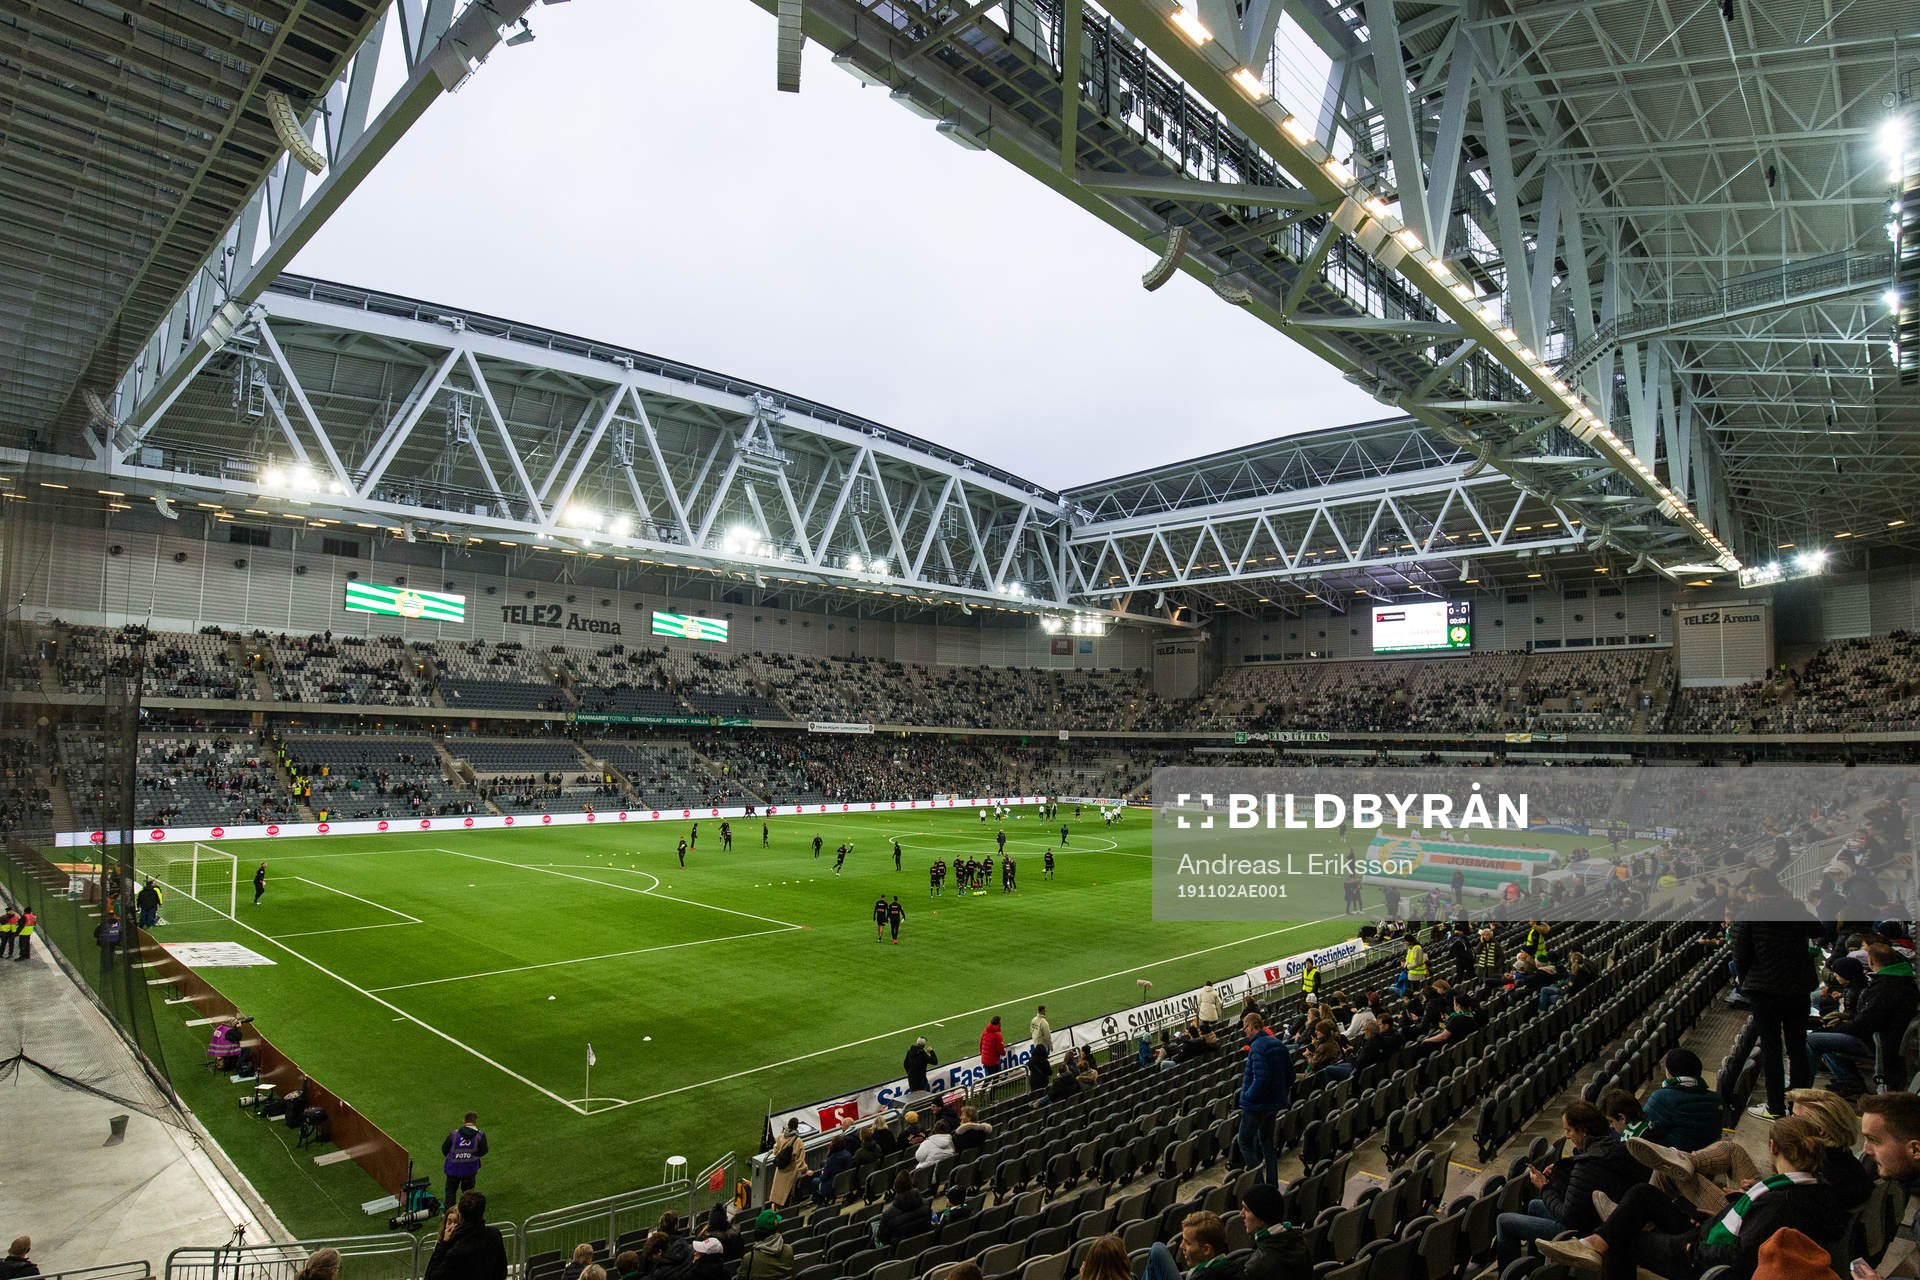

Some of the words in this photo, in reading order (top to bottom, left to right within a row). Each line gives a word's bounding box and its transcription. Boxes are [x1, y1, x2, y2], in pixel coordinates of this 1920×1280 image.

[1448, 607, 1454, 615] 0
[1461, 606, 1467, 614] 0
[501, 604, 562, 629] TELE2
[566, 613, 621, 635] Arena
[1683, 612, 1720, 626] TELE2
[1724, 614, 1760, 624] Arena
[1447, 857, 1505, 870] JOBMAN
[1286, 959, 1308, 975] Sten
[877, 1078, 945, 1108] Sta
